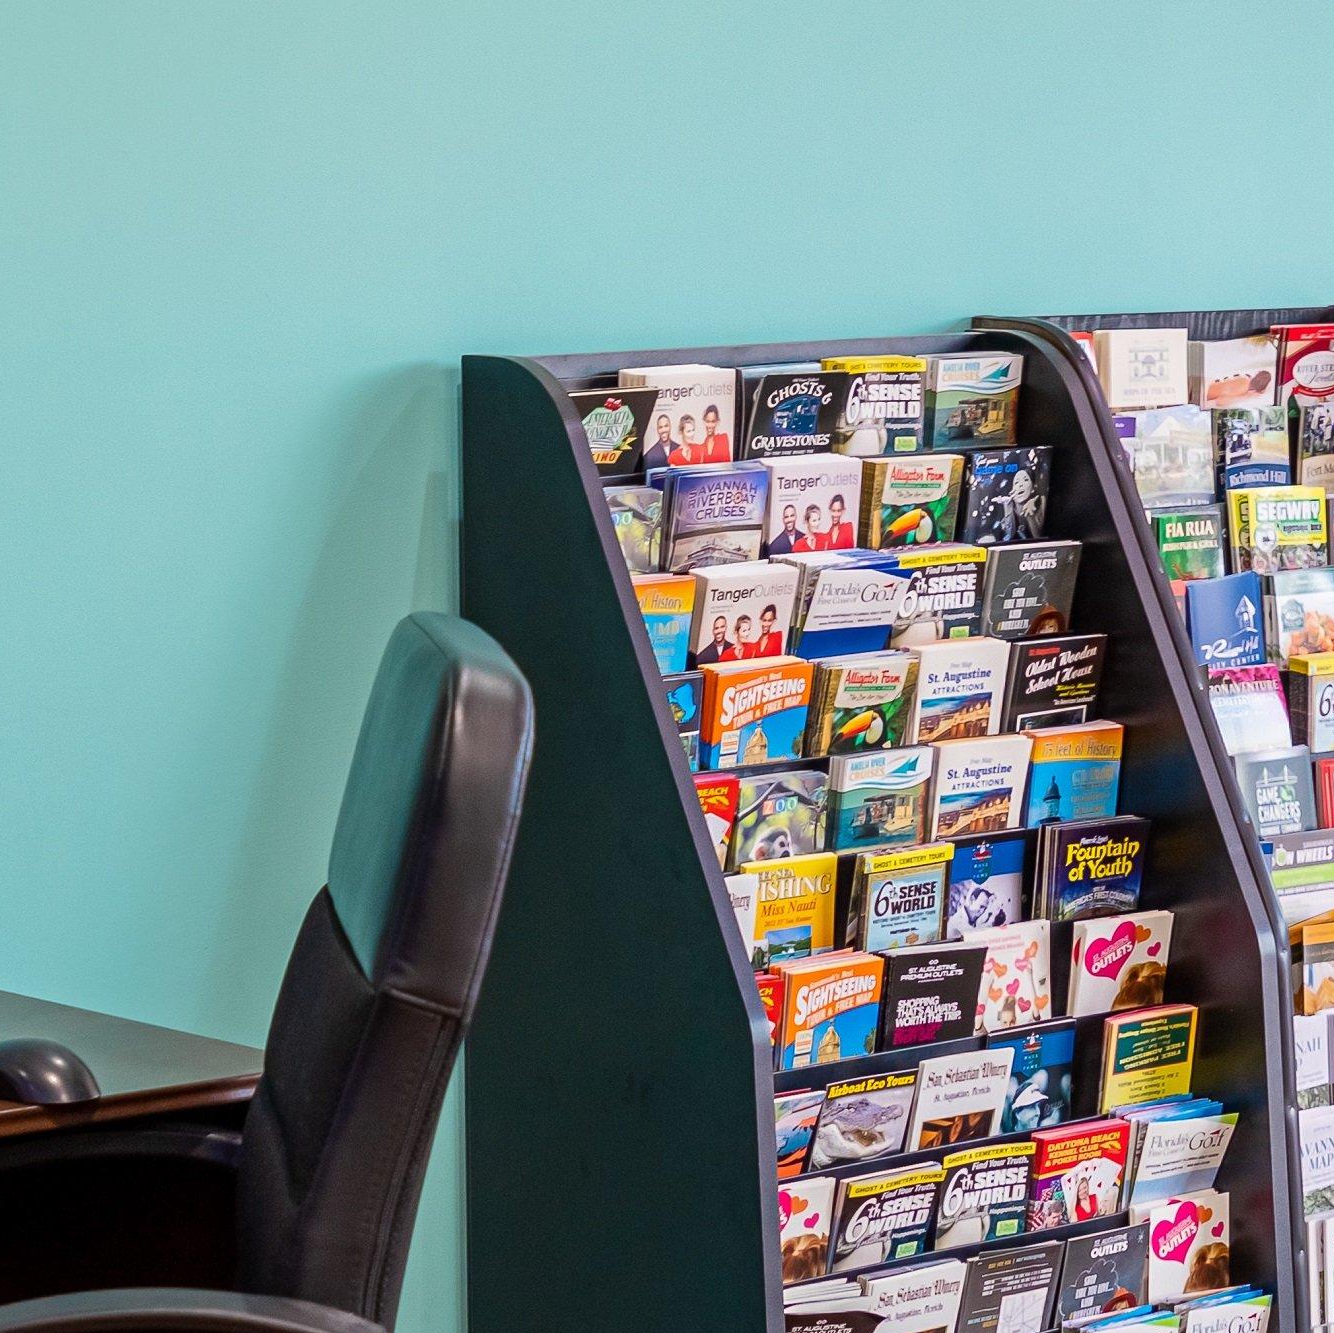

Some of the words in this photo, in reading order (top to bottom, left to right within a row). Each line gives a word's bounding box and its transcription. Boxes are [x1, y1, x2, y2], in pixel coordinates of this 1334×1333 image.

[655, 383, 733, 401] angerOutlets
[767, 383, 825, 409] GHOSTS
[860, 400, 922, 420] WORLD
[751, 433, 832, 451] GRAVESTONES
[890, 466, 924, 483] Alligator
[926, 467, 946, 482] Farm
[1228, 471, 1265, 486] Richmond
[1267, 469, 1287, 484] Hill
[1306, 464, 1323, 478] Fort
[689, 480, 759, 498] SAVANNAH
[776, 472, 860, 491] TangerOutlets
[687, 491, 757, 510] RIVERBOAT
[1256, 499, 1320, 522] SEGWAY
[695, 505, 747, 521] CRUISES
[1165, 523, 1185, 539] FIA
[1185, 519, 1215, 537] RUA
[1018, 558, 1058, 572] OUTLETS
[819, 581, 862, 598] Florida's
[926, 573, 978, 595] SENSE
[920, 590, 976, 612] WORLD
[1025, 654, 1058, 678] Oldest
[1058, 645, 1098, 666] Wooden
[844, 669, 879, 686] Alligator
[880, 669, 902, 685] Farm
[927, 672, 941, 684] St.
[943, 667, 993, 685] Augustine
[1025, 674, 1061, 696] School
[1061, 663, 1094, 684] House
[931, 682, 985, 696] ATTRACTIONS
[720, 677, 807, 726] SIGHTSEEING
[1074, 740, 1085, 756] of
[1086, 739, 1118, 758] History
[946, 768, 961, 780] St.
[962, 763, 1013, 781] Augustine
[950, 777, 1005, 792] ATTRACTIONS
[762, 796, 799, 816] ZOO
[1255, 787, 1279, 805] GAME
[1257, 800, 1303, 824] CHANGERS
[1065, 837, 1140, 868] Fountain
[1067, 863, 1086, 882] of
[1084, 858, 1133, 880] Youth
[761, 903, 785, 918] Miss
[787, 898, 817, 914] Nauti
[874, 880, 899, 918] 6th
[898, 880, 938, 900] SENSE
[890, 894, 937, 916] WORLD
[1091, 941, 1134, 974] OUTLETS
[900, 970, 932, 982] PREMIUM
[932, 968, 965, 979] OUTLETS
[908, 966, 919, 975] ST.
[918, 963, 958, 975] AUGUSTINE
[794, 974, 877, 1027] SIGHTSEEING
[897, 995, 940, 1008] SHOPPING
[894, 1014, 926, 1028] WORTH
[925, 1012, 941, 1024] THE
[926, 1072, 943, 1089] San
[945, 1066, 981, 1085] Sebastian
[980, 1061, 1009, 1080] Winery
[827, 1082, 868, 1099] Airboat
[867, 1078, 886, 1091] Eco
[886, 1074, 916, 1089] Tours
[1047, 1136, 1090, 1153] DAYTONA
[1091, 1131, 1121, 1146] BEACH
[1048, 1145, 1082, 1161] KENNEL
[1081, 1142, 1101, 1155] CLUB
[971, 1160, 988, 1172] Find
[987, 1159, 1008, 1170] Your
[1006, 1156, 1030, 1167] Truth.
[1307, 1153, 1334, 1172] MAP
[854, 1185, 878, 1195] GHOST
[878, 1183, 885, 1191] &
[884, 1176, 918, 1189] CEMETERY
[920, 1172, 944, 1182] TOURS
[942, 1167, 975, 1218] 6th
[973, 1166, 1029, 1190] SENSE
[964, 1183, 1027, 1209] WORLD
[845, 1196, 882, 1244] 6th
[880, 1192, 935, 1217] SENSE
[867, 1206, 932, 1232] WORLD
[1090, 1239, 1130, 1259] OUTLETS
[1158, 1222, 1199, 1259] OUTLETS
[878, 1291, 895, 1307] San
[897, 1284, 933, 1304] Sebastian
[933, 1278, 962, 1297] Winery
